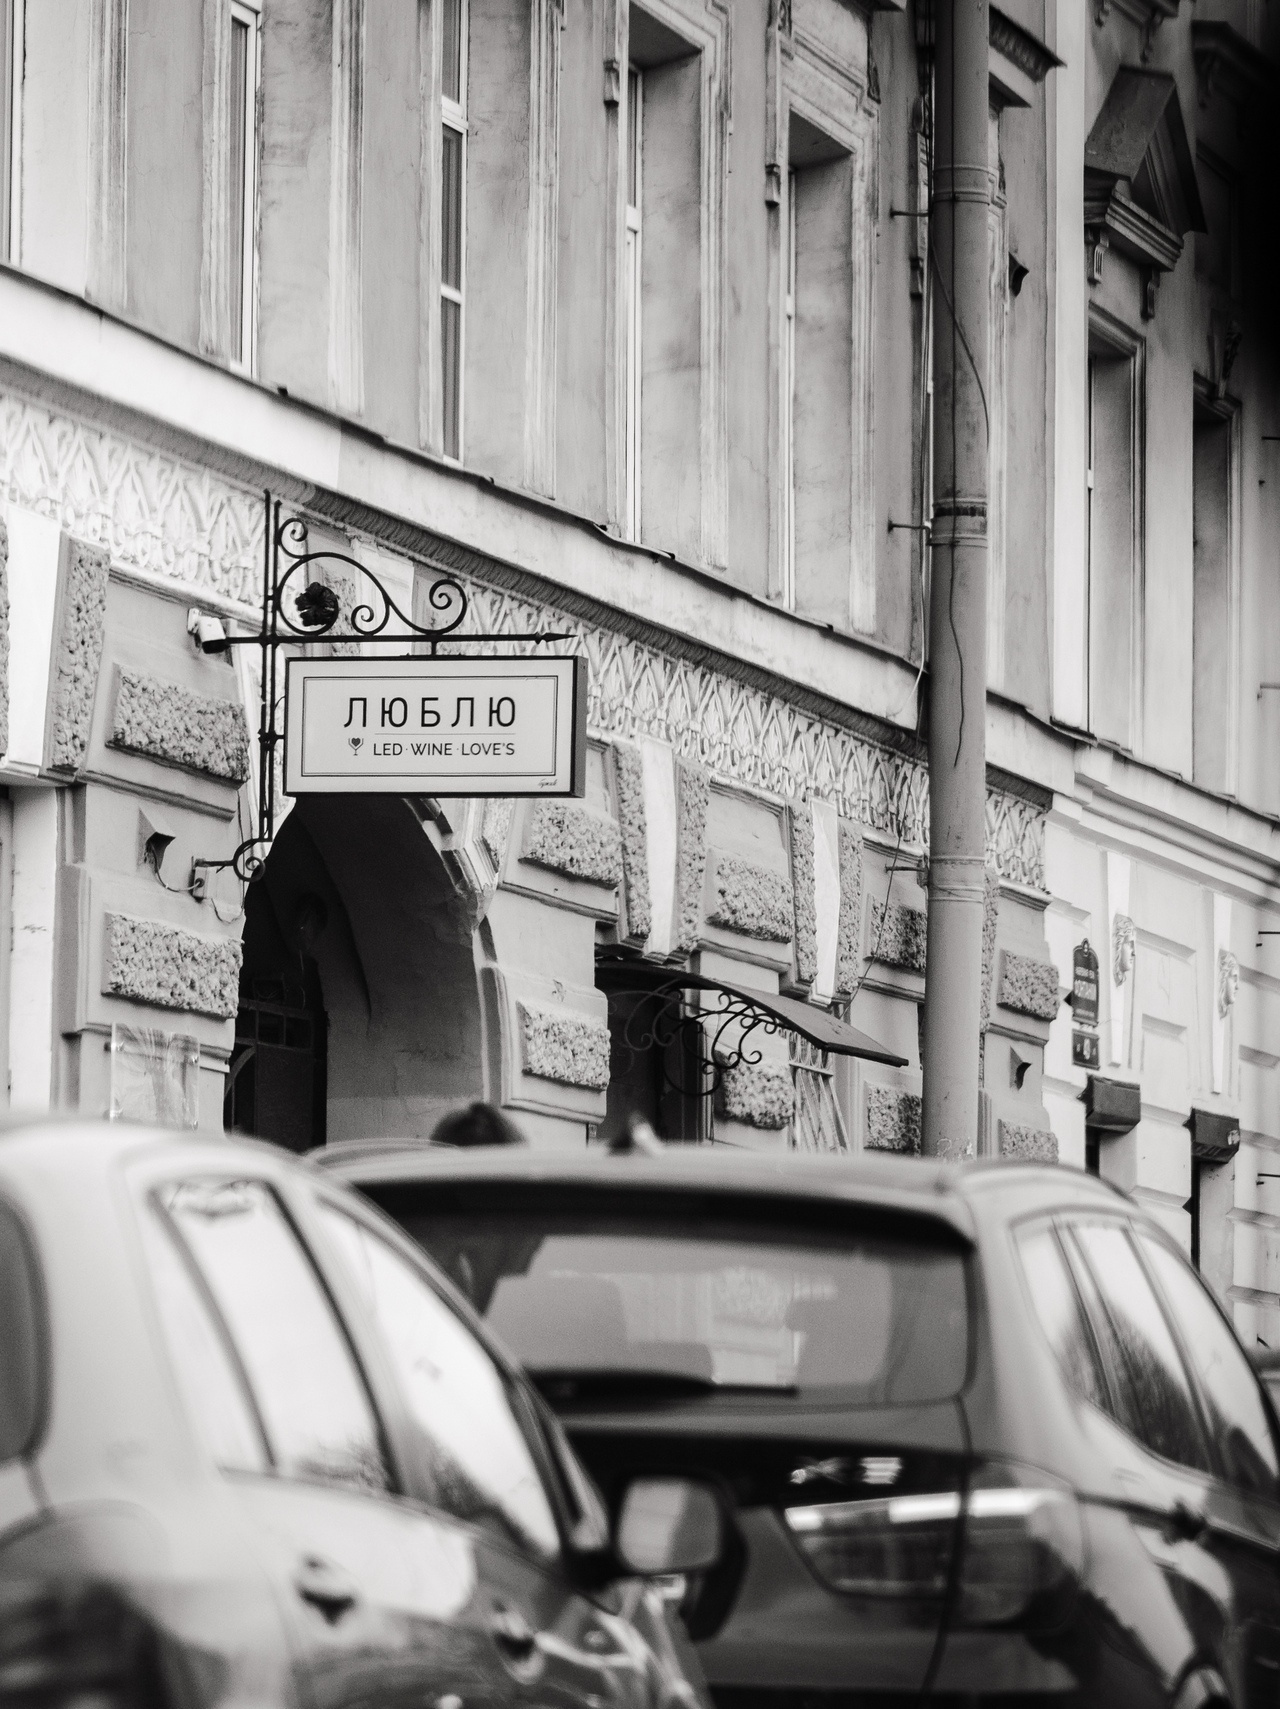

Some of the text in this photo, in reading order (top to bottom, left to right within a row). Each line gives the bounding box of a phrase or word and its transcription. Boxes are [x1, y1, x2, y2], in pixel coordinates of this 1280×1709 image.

[343, 696, 516, 728] ЛЮБЛЮ
[372, 742, 516, 756] LED WINE LOVE'S
